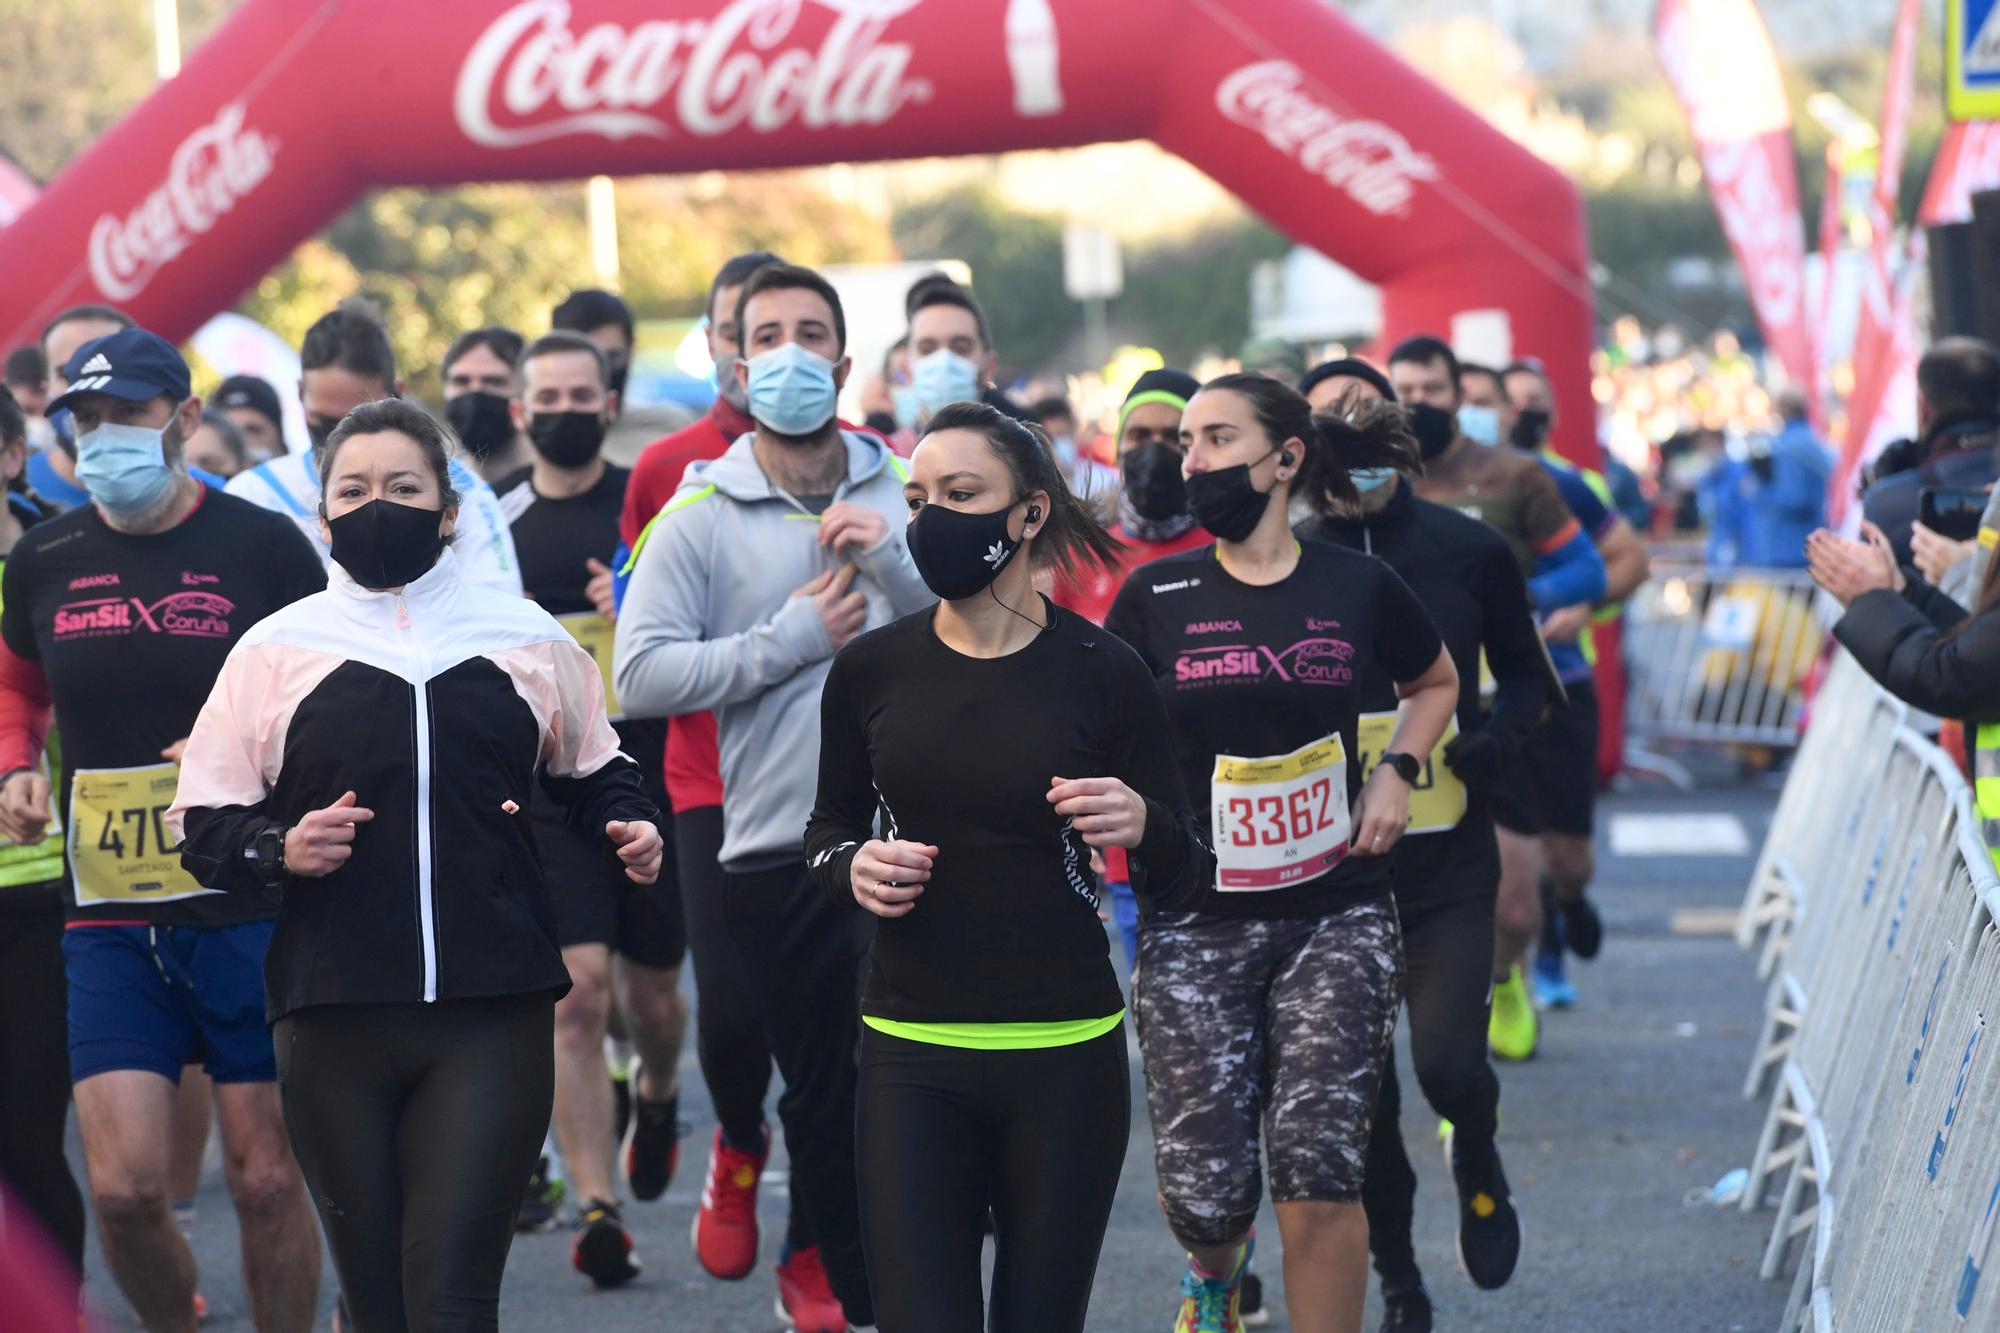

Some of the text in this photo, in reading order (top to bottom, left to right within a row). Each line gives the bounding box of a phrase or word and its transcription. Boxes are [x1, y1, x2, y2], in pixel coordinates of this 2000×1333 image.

[455, 0, 922, 148] Coca-Cola
[1215, 59, 1440, 217] Coca-Cola
[88, 101, 275, 302] Coca-Cola
[54, 603, 132, 634] SanSil
[162, 613, 229, 634] Coruña
[1175, 652, 1261, 682] SanSil
[1294, 660, 1352, 681] Coruña
[1228, 776, 1336, 847] 3362
